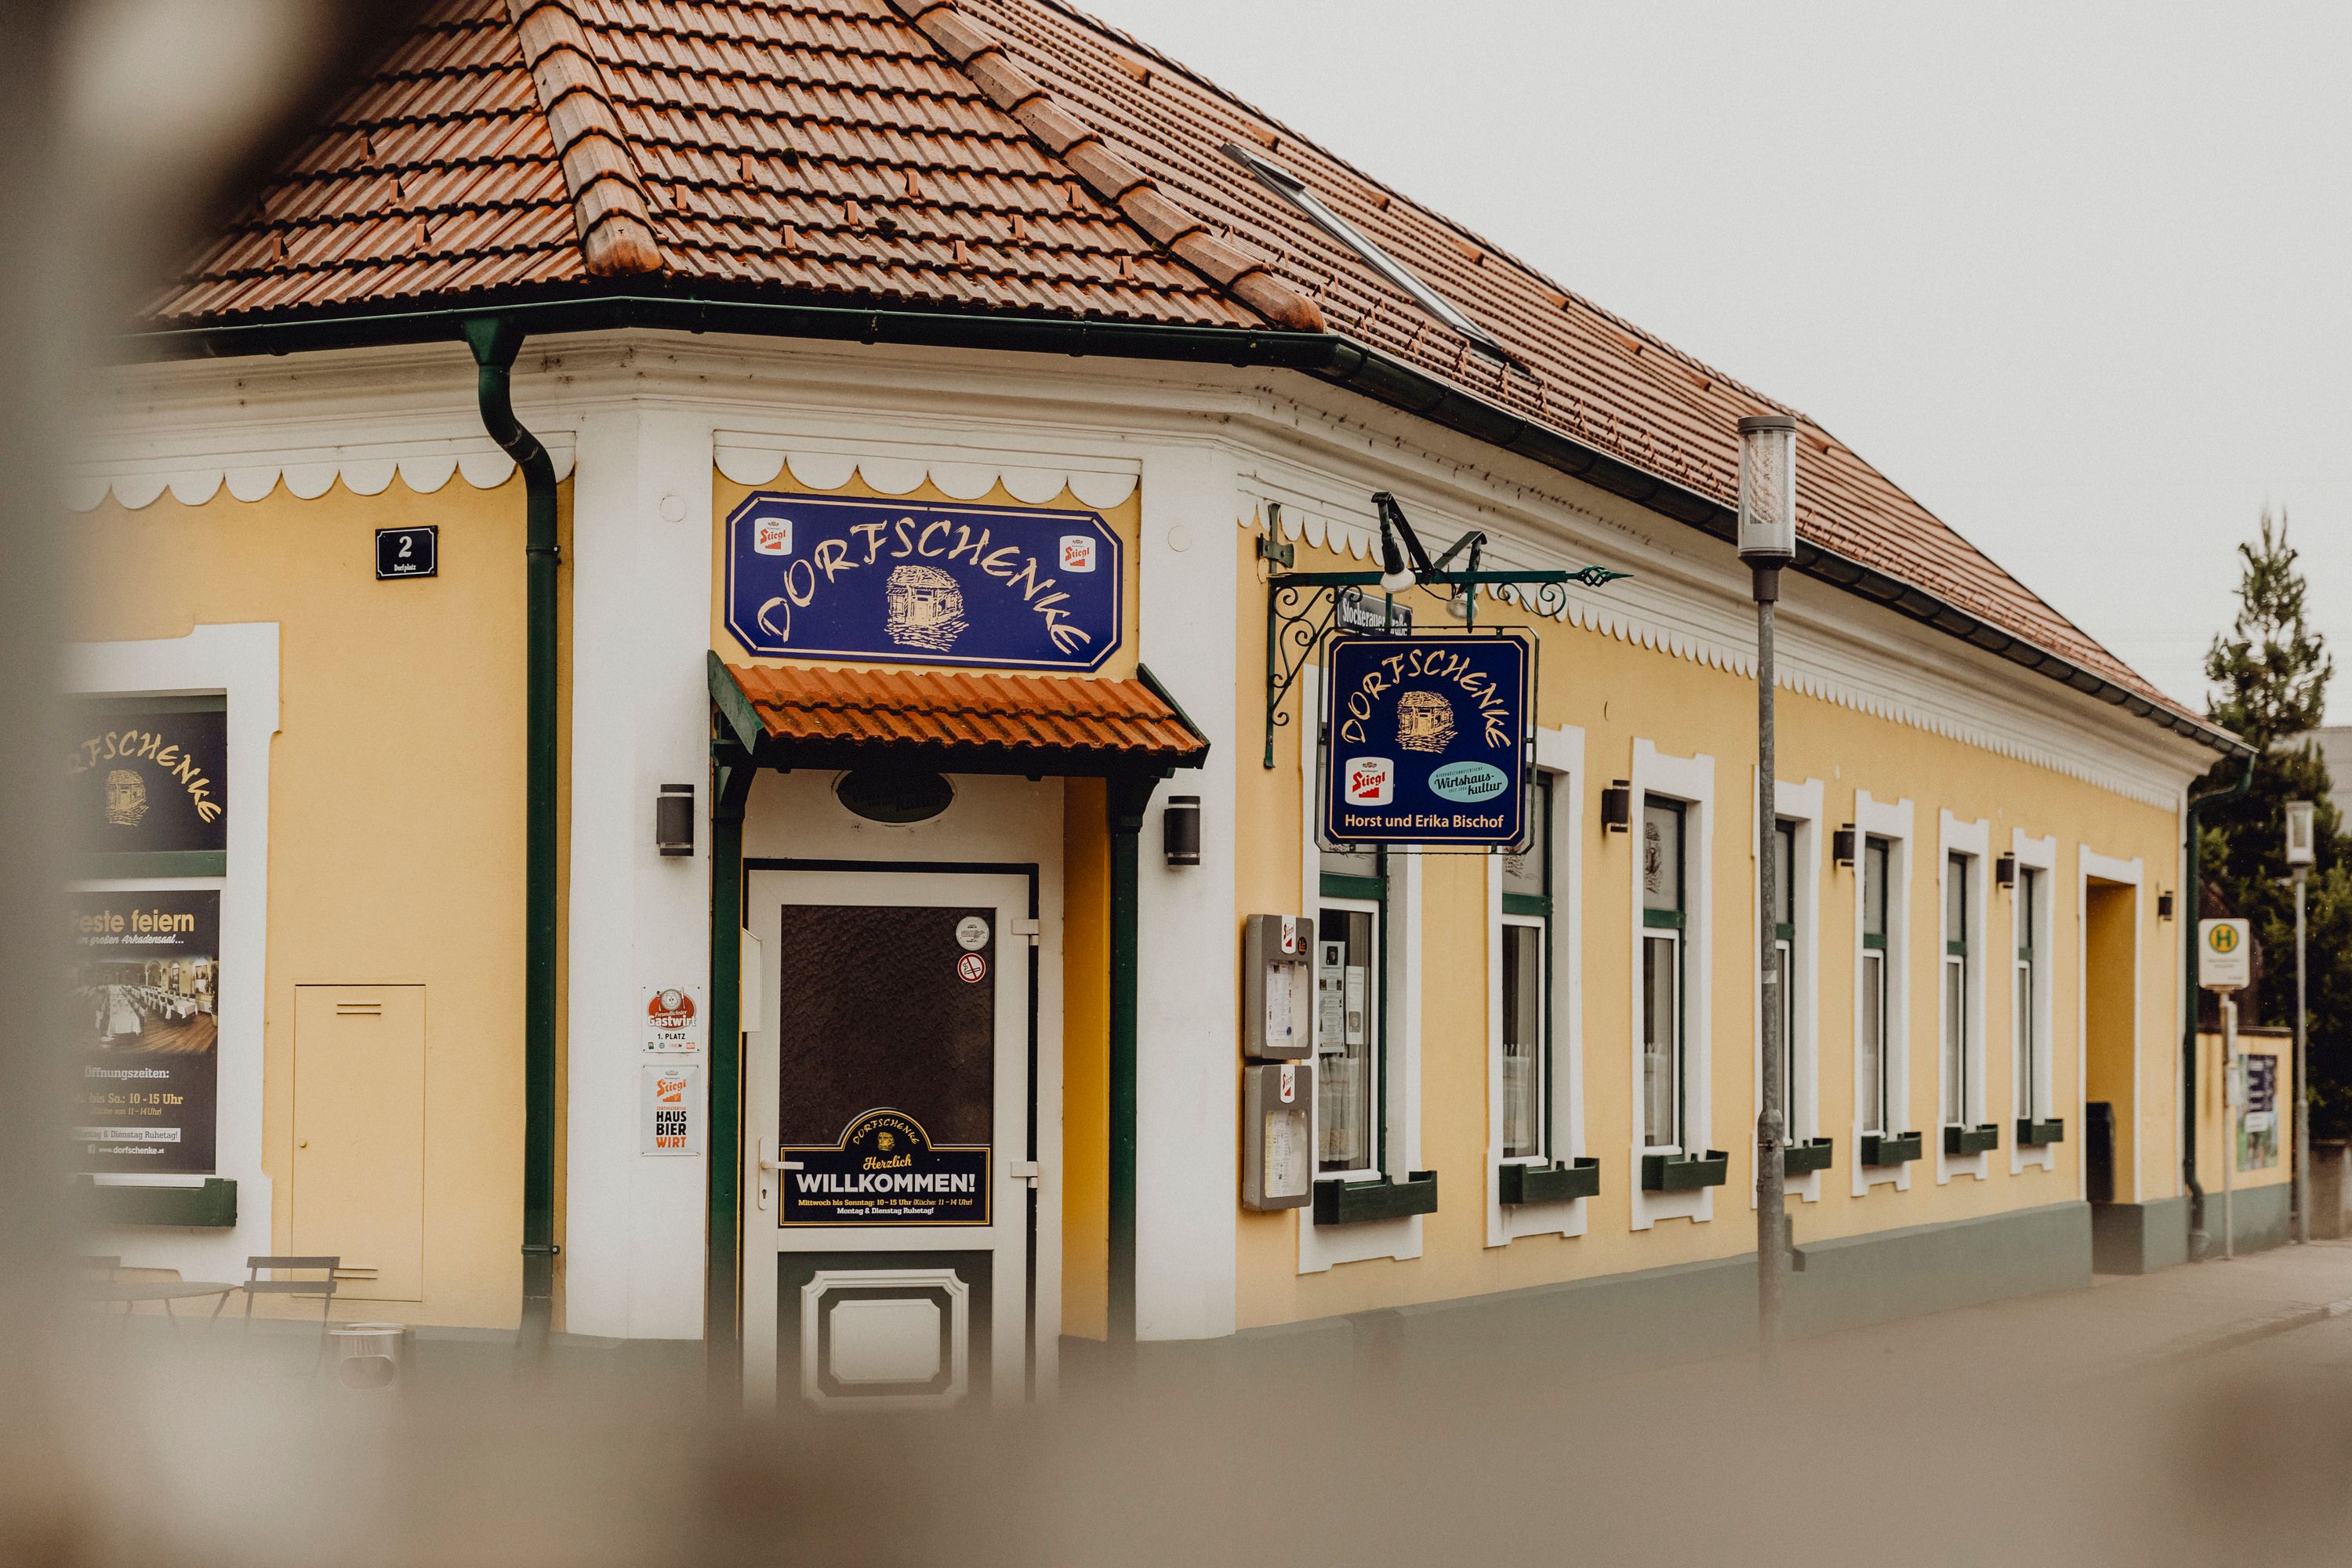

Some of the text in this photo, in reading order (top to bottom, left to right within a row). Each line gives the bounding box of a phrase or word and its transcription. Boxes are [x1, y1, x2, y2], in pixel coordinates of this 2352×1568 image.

[760, 528, 786, 544] Stiegl
[398, 535, 412, 558] 2
[1065, 546, 1090, 562] Stiegl
[394, 564, 416, 573] Dorfplatz
[757, 517, 1091, 655] DORFSCHENKE
[1341, 649, 1512, 748] DORFSCHENKE
[1352, 771, 1385, 793] Stiegl
[1434, 773, 1494, 789] Wirtshaus-
[1468, 782, 1502, 795] kultur
[1345, 815, 1504, 828] Horst und Erika Bischof
[131, 909, 194, 932] feiern
[89, 935, 119, 946] großen
[122, 934, 185, 945] Arkadensaal...
[648, 1014, 697, 1027] Gastwirt
[657, 1079, 686, 1098] Stiegl
[129, 1093, 140, 1104] 10
[149, 1094, 160, 1105] 15
[163, 1094, 183, 1105] Uhr
[656, 1111, 686, 1122] HAUS
[111, 1131, 143, 1140] Dienstag
[145, 1131, 177, 1141] Ruhetag!
[656, 1123, 686, 1135] BIER
[853, 1119, 920, 1145] DORFSCHENKE
[656, 1137, 686, 1148] WIRT
[863, 1154, 912, 1171] Herzlich
[796, 1174, 975, 1192] WILLKOMMEN!
[844, 1199, 875, 1207] Sonntag:
